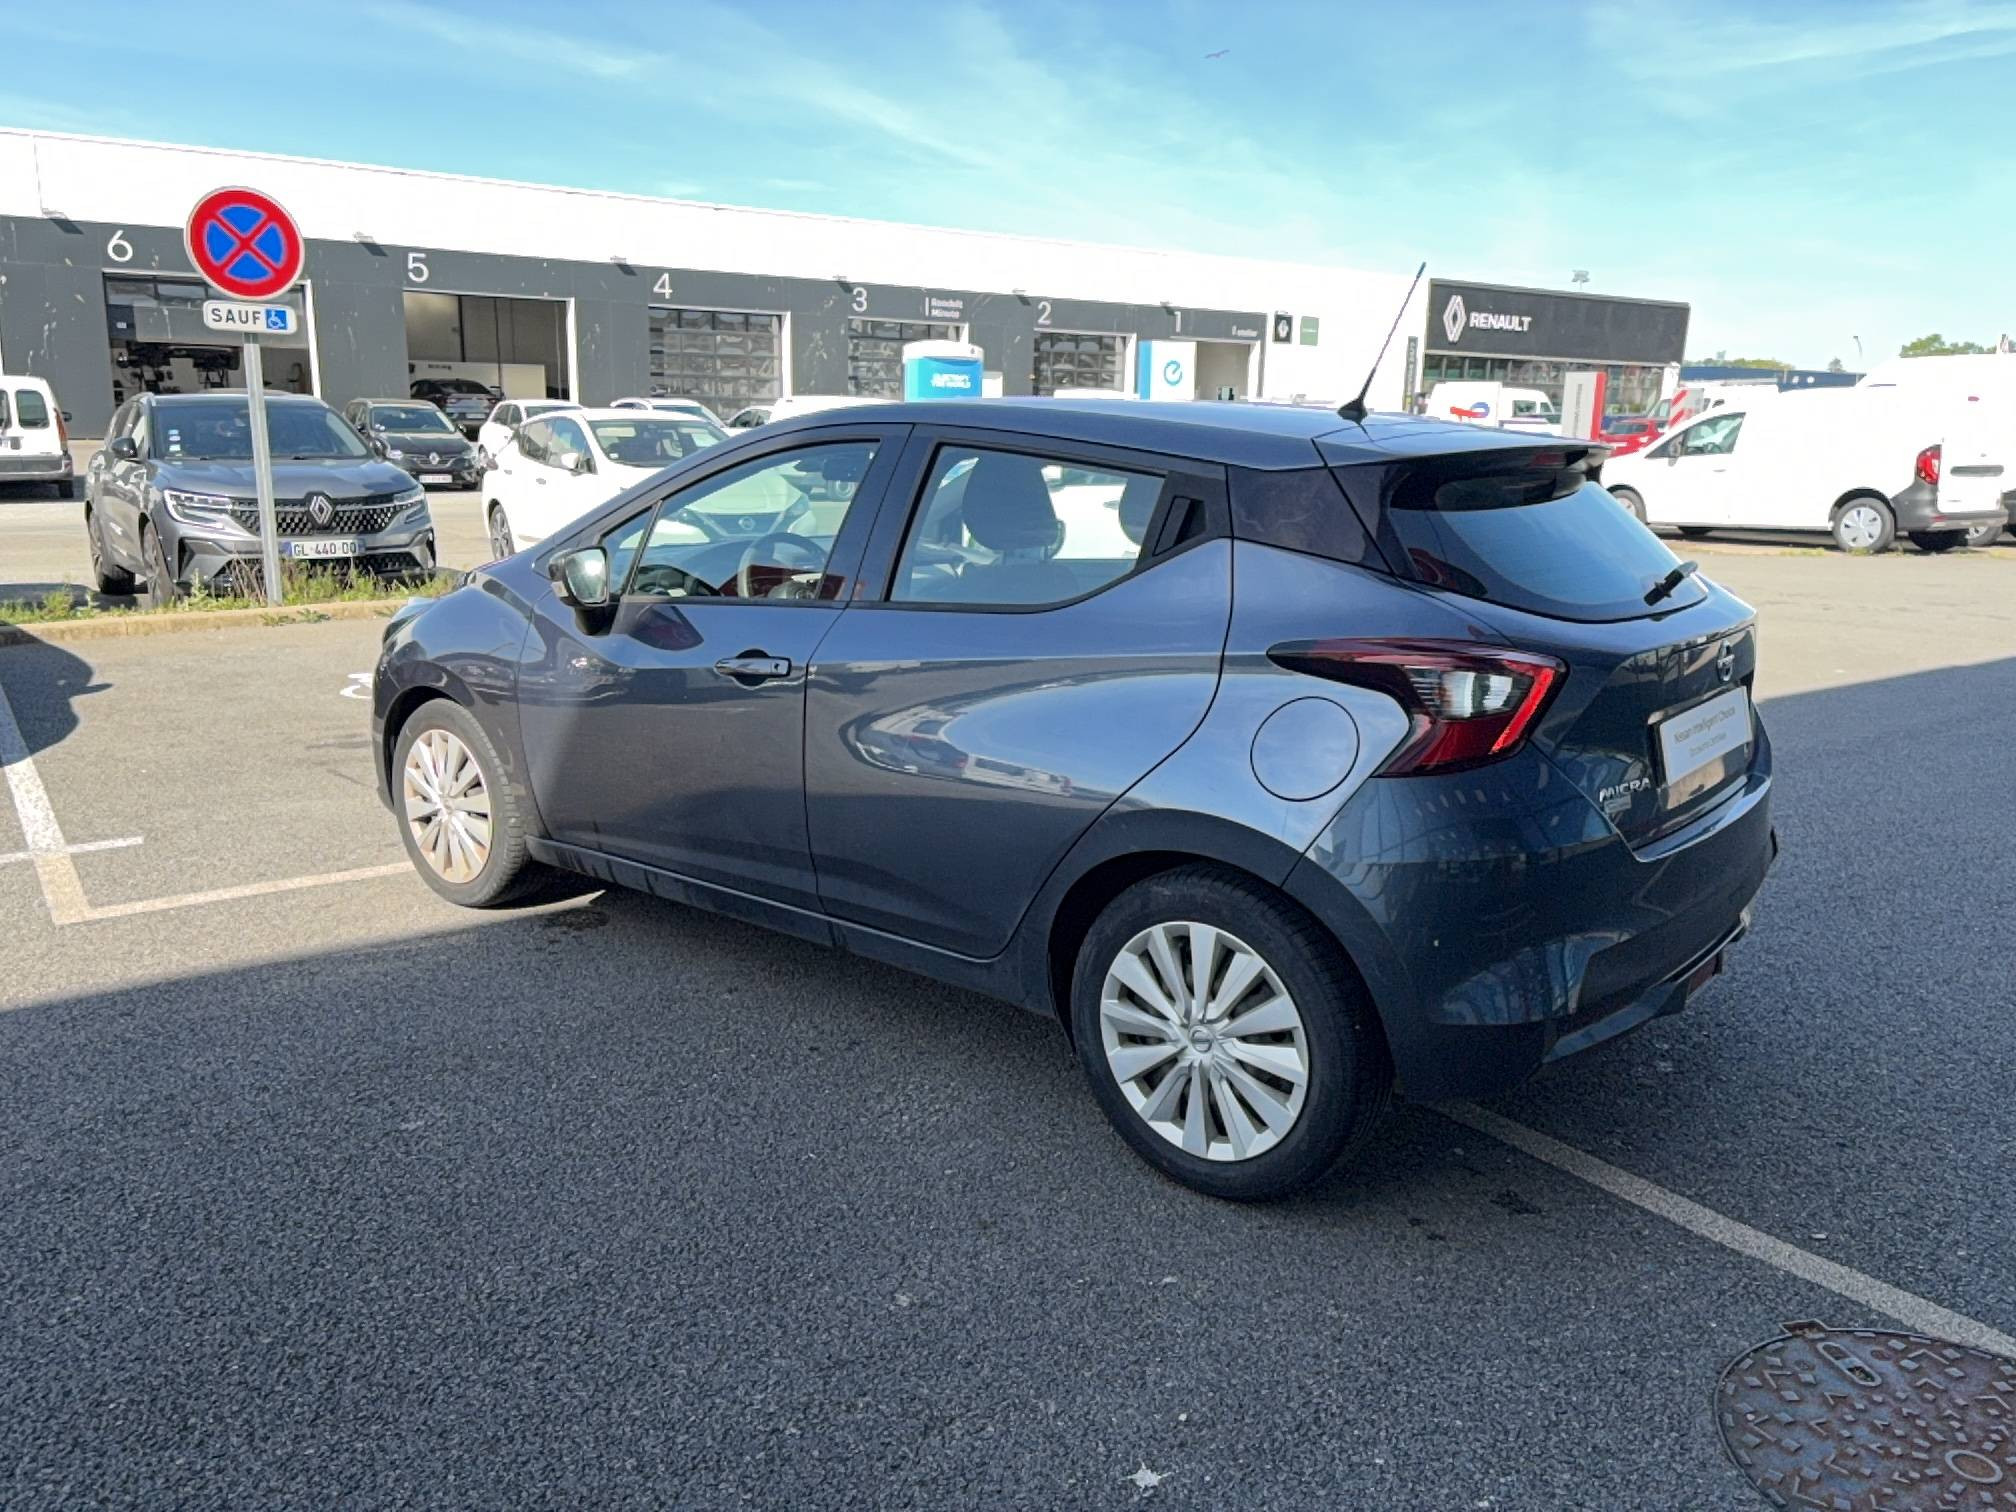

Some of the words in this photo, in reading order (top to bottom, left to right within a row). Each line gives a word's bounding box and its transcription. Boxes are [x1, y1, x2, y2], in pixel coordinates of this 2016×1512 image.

[106, 229, 134, 263] 6
[407, 251, 430, 283] 5
[652, 272, 674, 300] 4
[851, 287, 869, 313] 3
[210, 307, 261, 326] SAUF
[1037, 301, 1052, 326] 2
[1174, 310, 1182, 333] 1
[1468, 311, 1532, 332] RENAULT
[1599, 777, 1651, 803] MICRA
